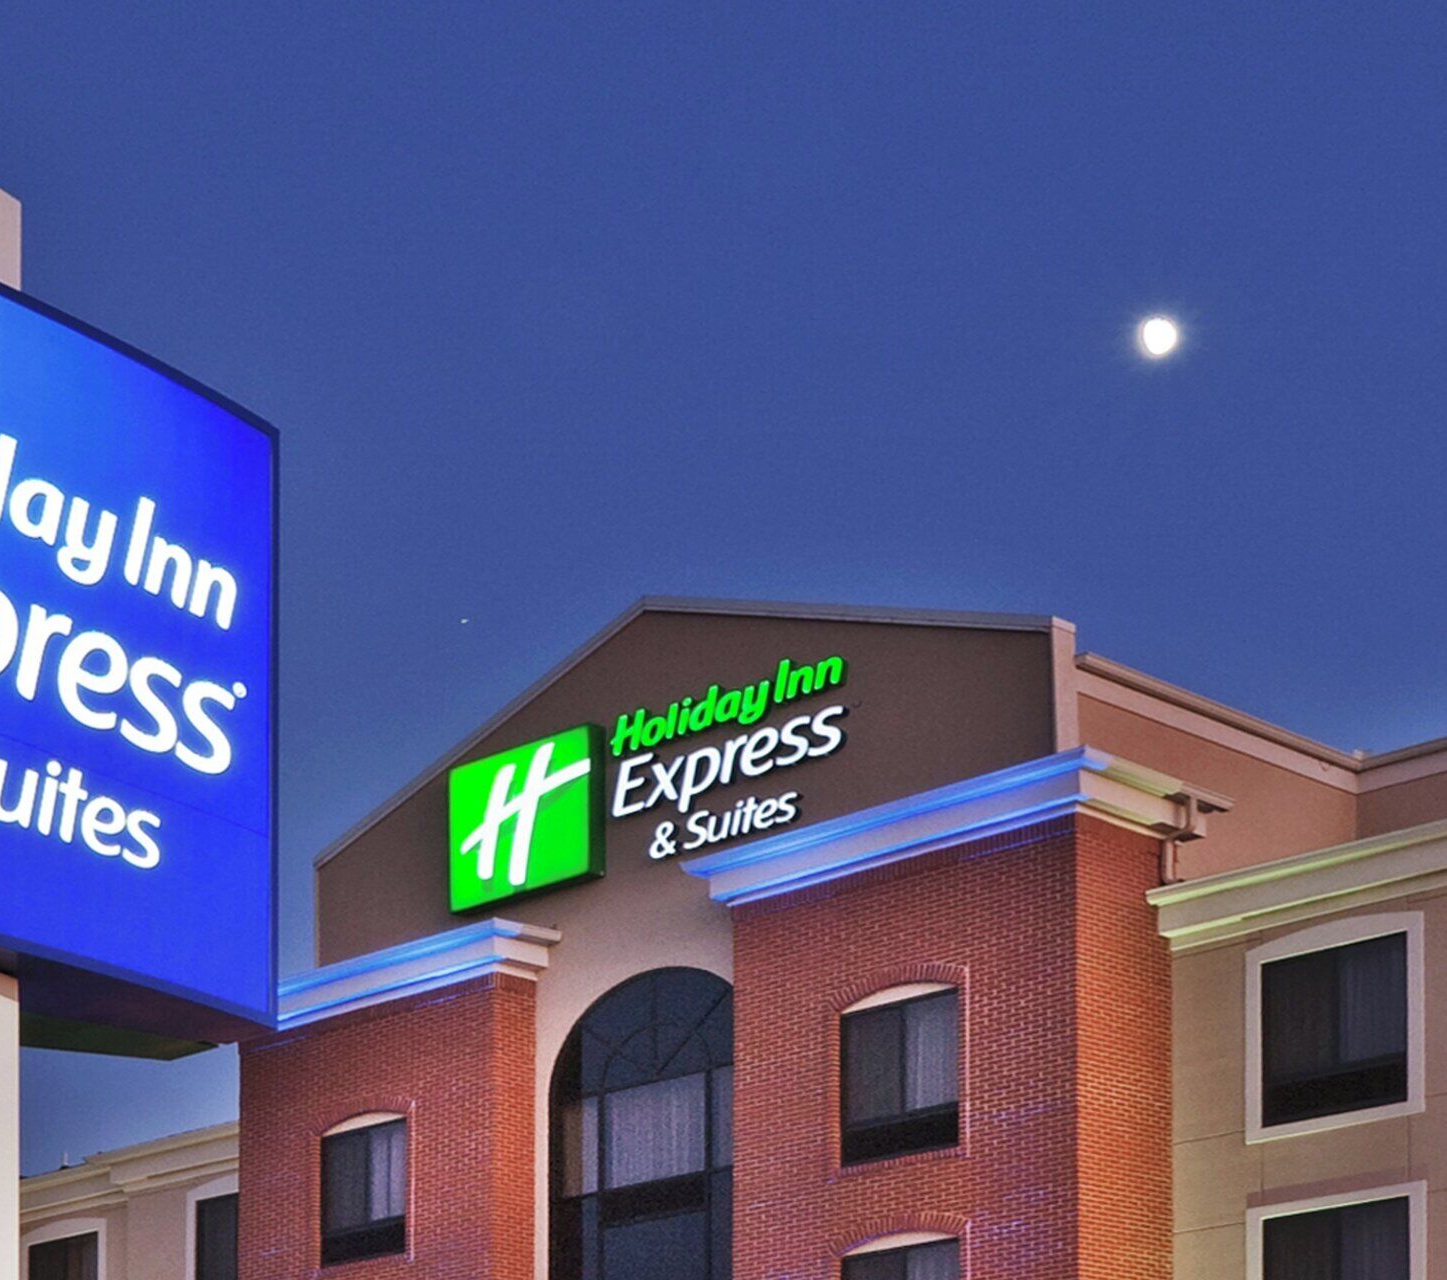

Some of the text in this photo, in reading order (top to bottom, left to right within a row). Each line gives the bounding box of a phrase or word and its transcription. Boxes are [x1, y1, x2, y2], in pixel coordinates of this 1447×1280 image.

[123, 496, 238, 631] Inn
[610, 655, 844, 756] Holiday Inn
[610, 705, 844, 818] Express
[648, 791, 799, 859] & Suites
